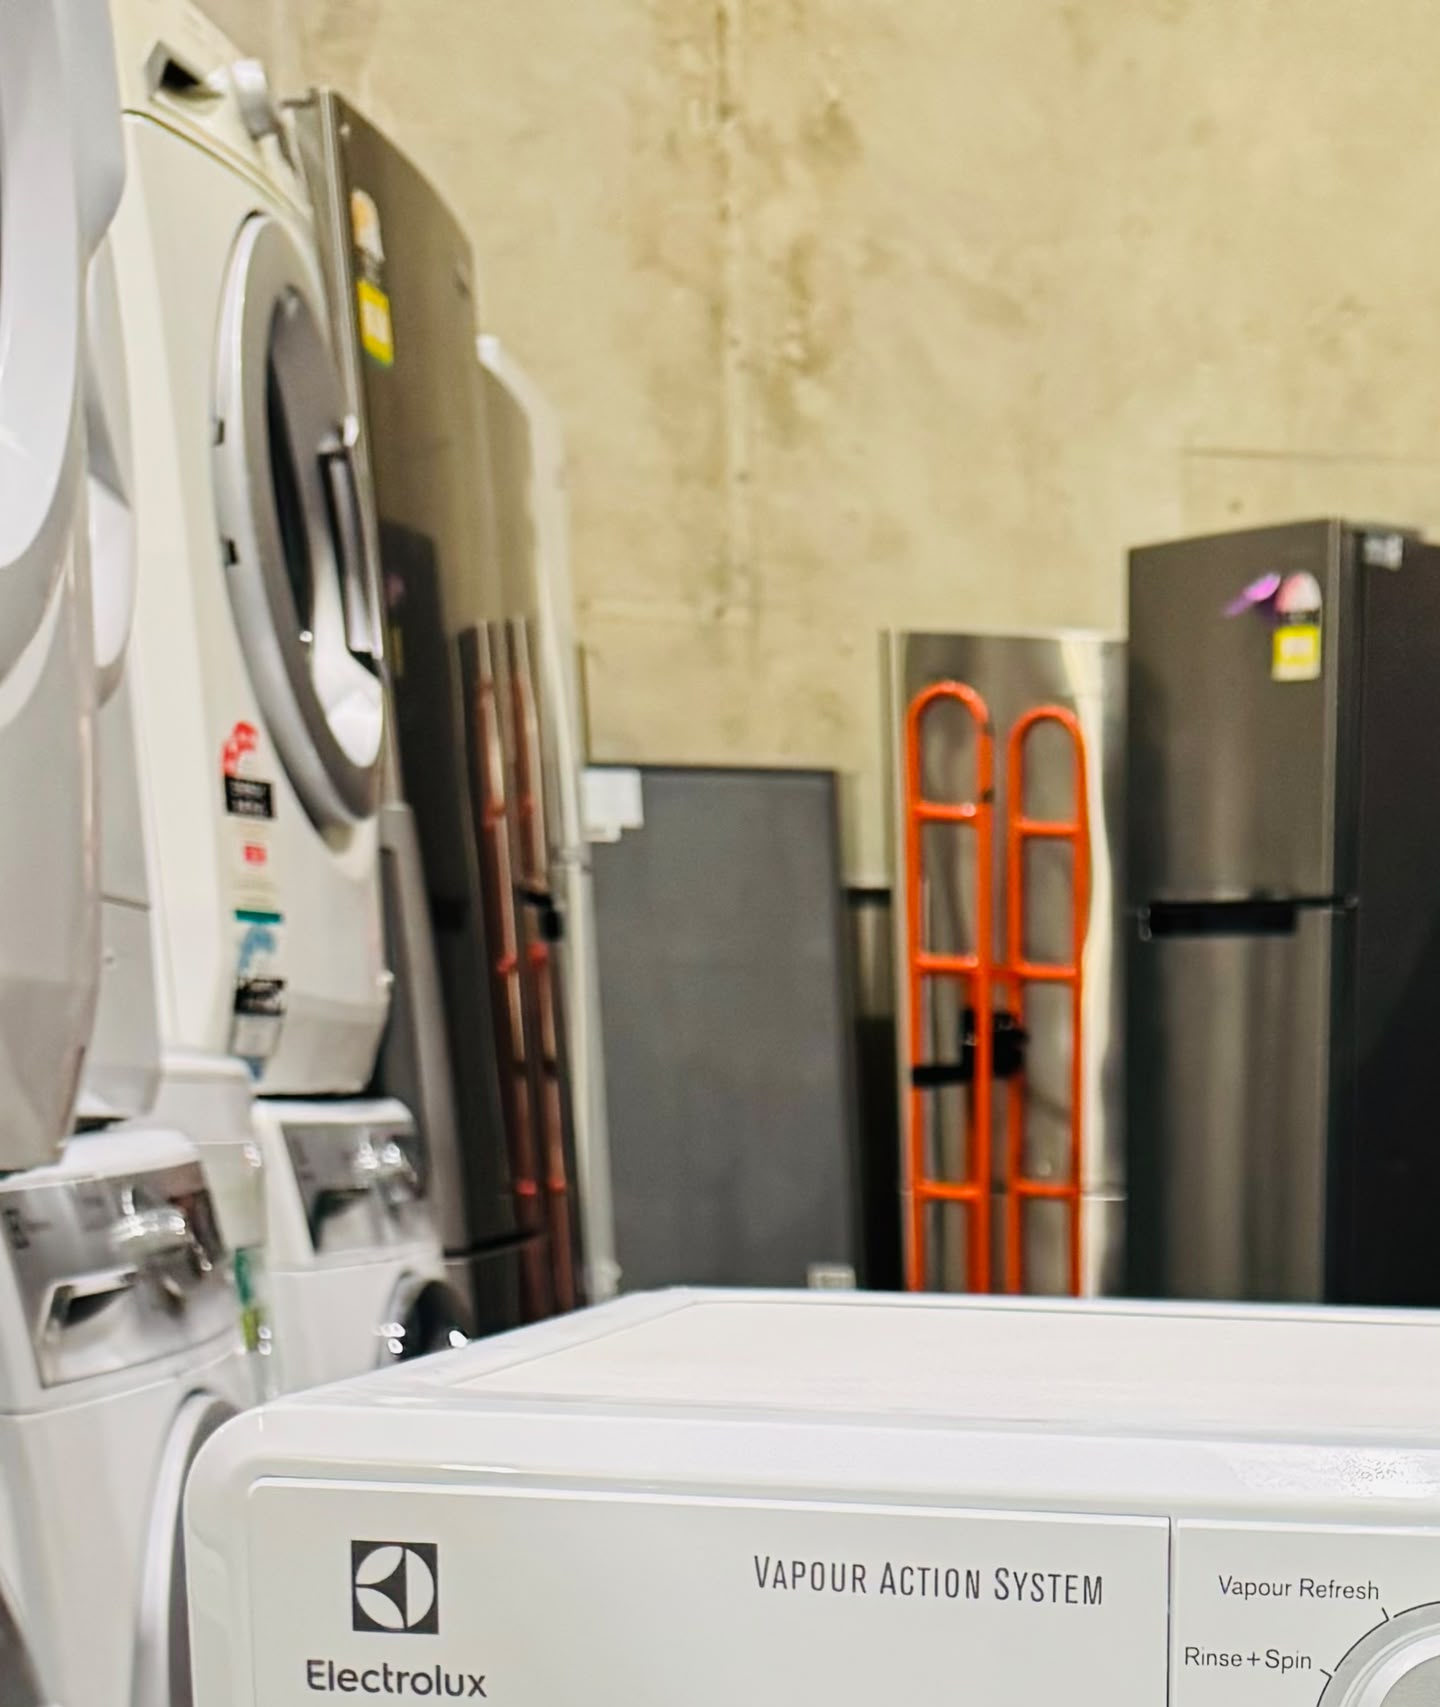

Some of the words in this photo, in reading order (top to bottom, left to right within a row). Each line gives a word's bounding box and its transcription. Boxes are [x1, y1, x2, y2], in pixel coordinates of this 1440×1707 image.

[754, 1555, 867, 1595] VAPOUR
[879, 1562, 981, 1601] ACTION
[993, 1566, 1104, 1606] SYSTEM
[1218, 1575, 1292, 1601] Vapour
[1299, 1577, 1379, 1600] Refresh
[306, 1658, 488, 1699] Electrolux
